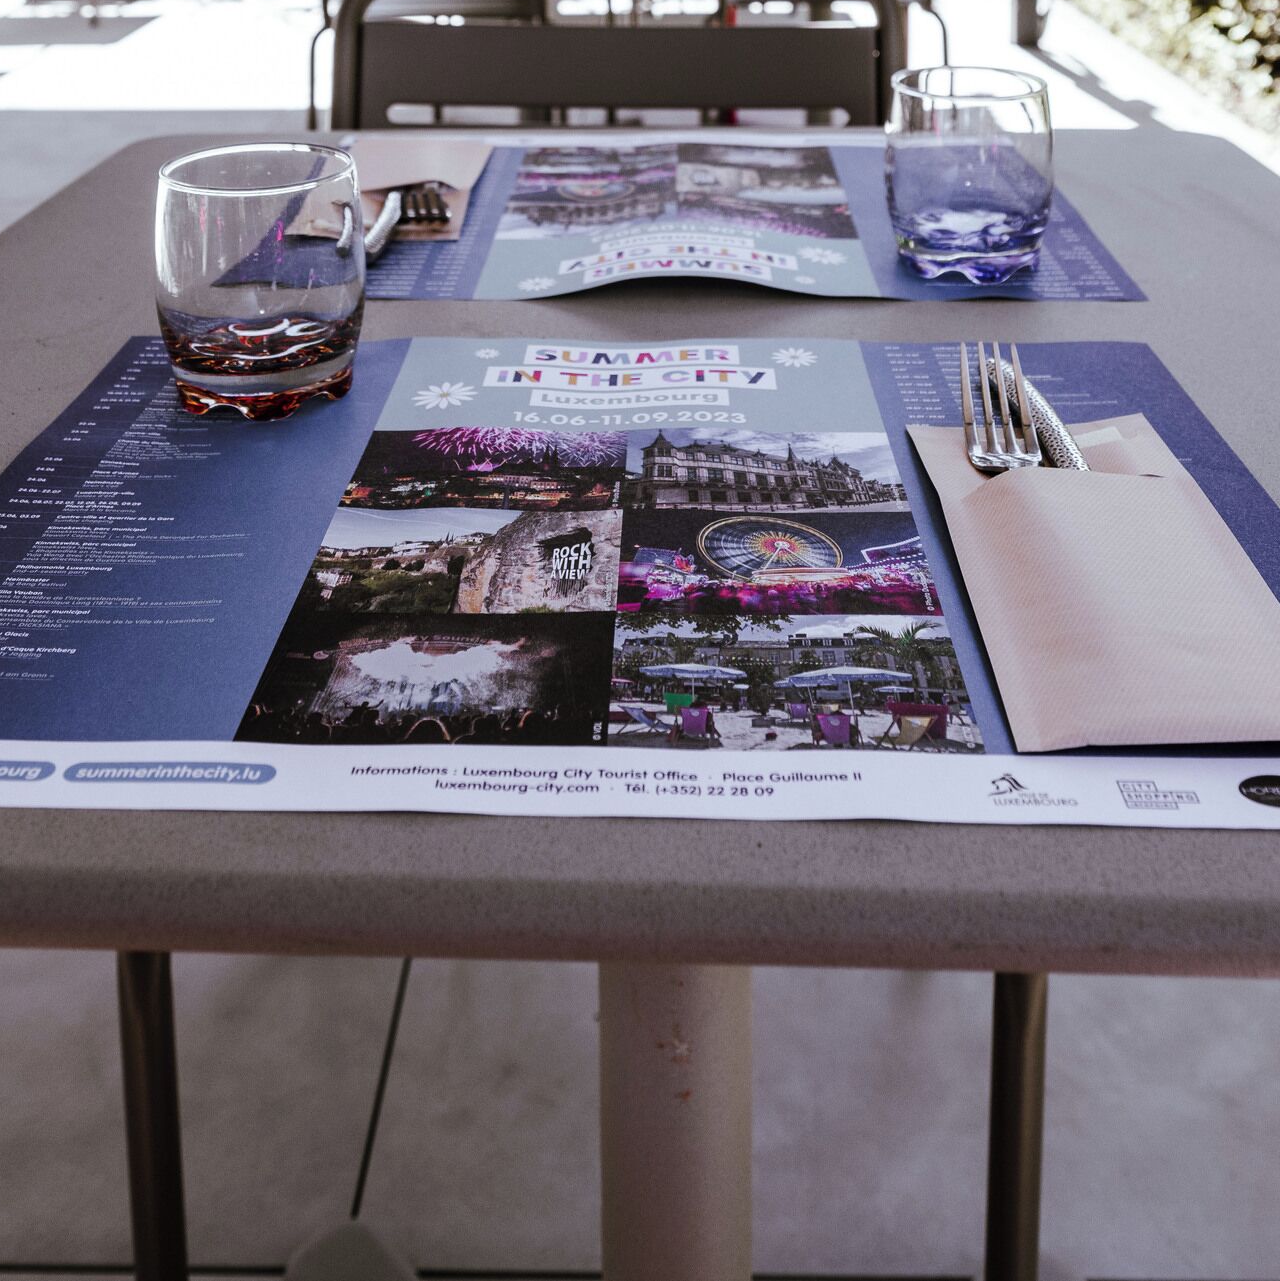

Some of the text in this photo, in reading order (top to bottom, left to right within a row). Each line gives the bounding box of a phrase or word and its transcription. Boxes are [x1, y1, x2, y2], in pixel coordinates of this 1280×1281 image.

[592, 259, 763, 277] SUMMER
[535, 347, 729, 365] SUMMER
[497, 368, 766, 387] IN THE CITY
[540, 389, 720, 406] Luxembourg
[513, 410, 747, 426] 16.06-11.09.2023
[552, 541, 592, 559] ROCK
[552, 554, 591, 570] WITH
[550, 569, 590, 580] A VIEW
[76, 764, 261, 785] summerinthecity.lu
[350, 766, 448, 777] Informations
[463, 767, 558, 780] Luxembourg
[563, 769, 592, 780] City
[598, 769, 648, 780] Tourist
[653, 770, 698, 782] Office
[722, 772, 765, 783] Place
[769, 772, 849, 783] Guillaume
[435, 779, 775, 798] luxembourg-city.com Tél. (+352) 22 28 09
[1122, 782, 1153, 791] CITY
[993, 797, 1079, 807] LUXEMBOURG
